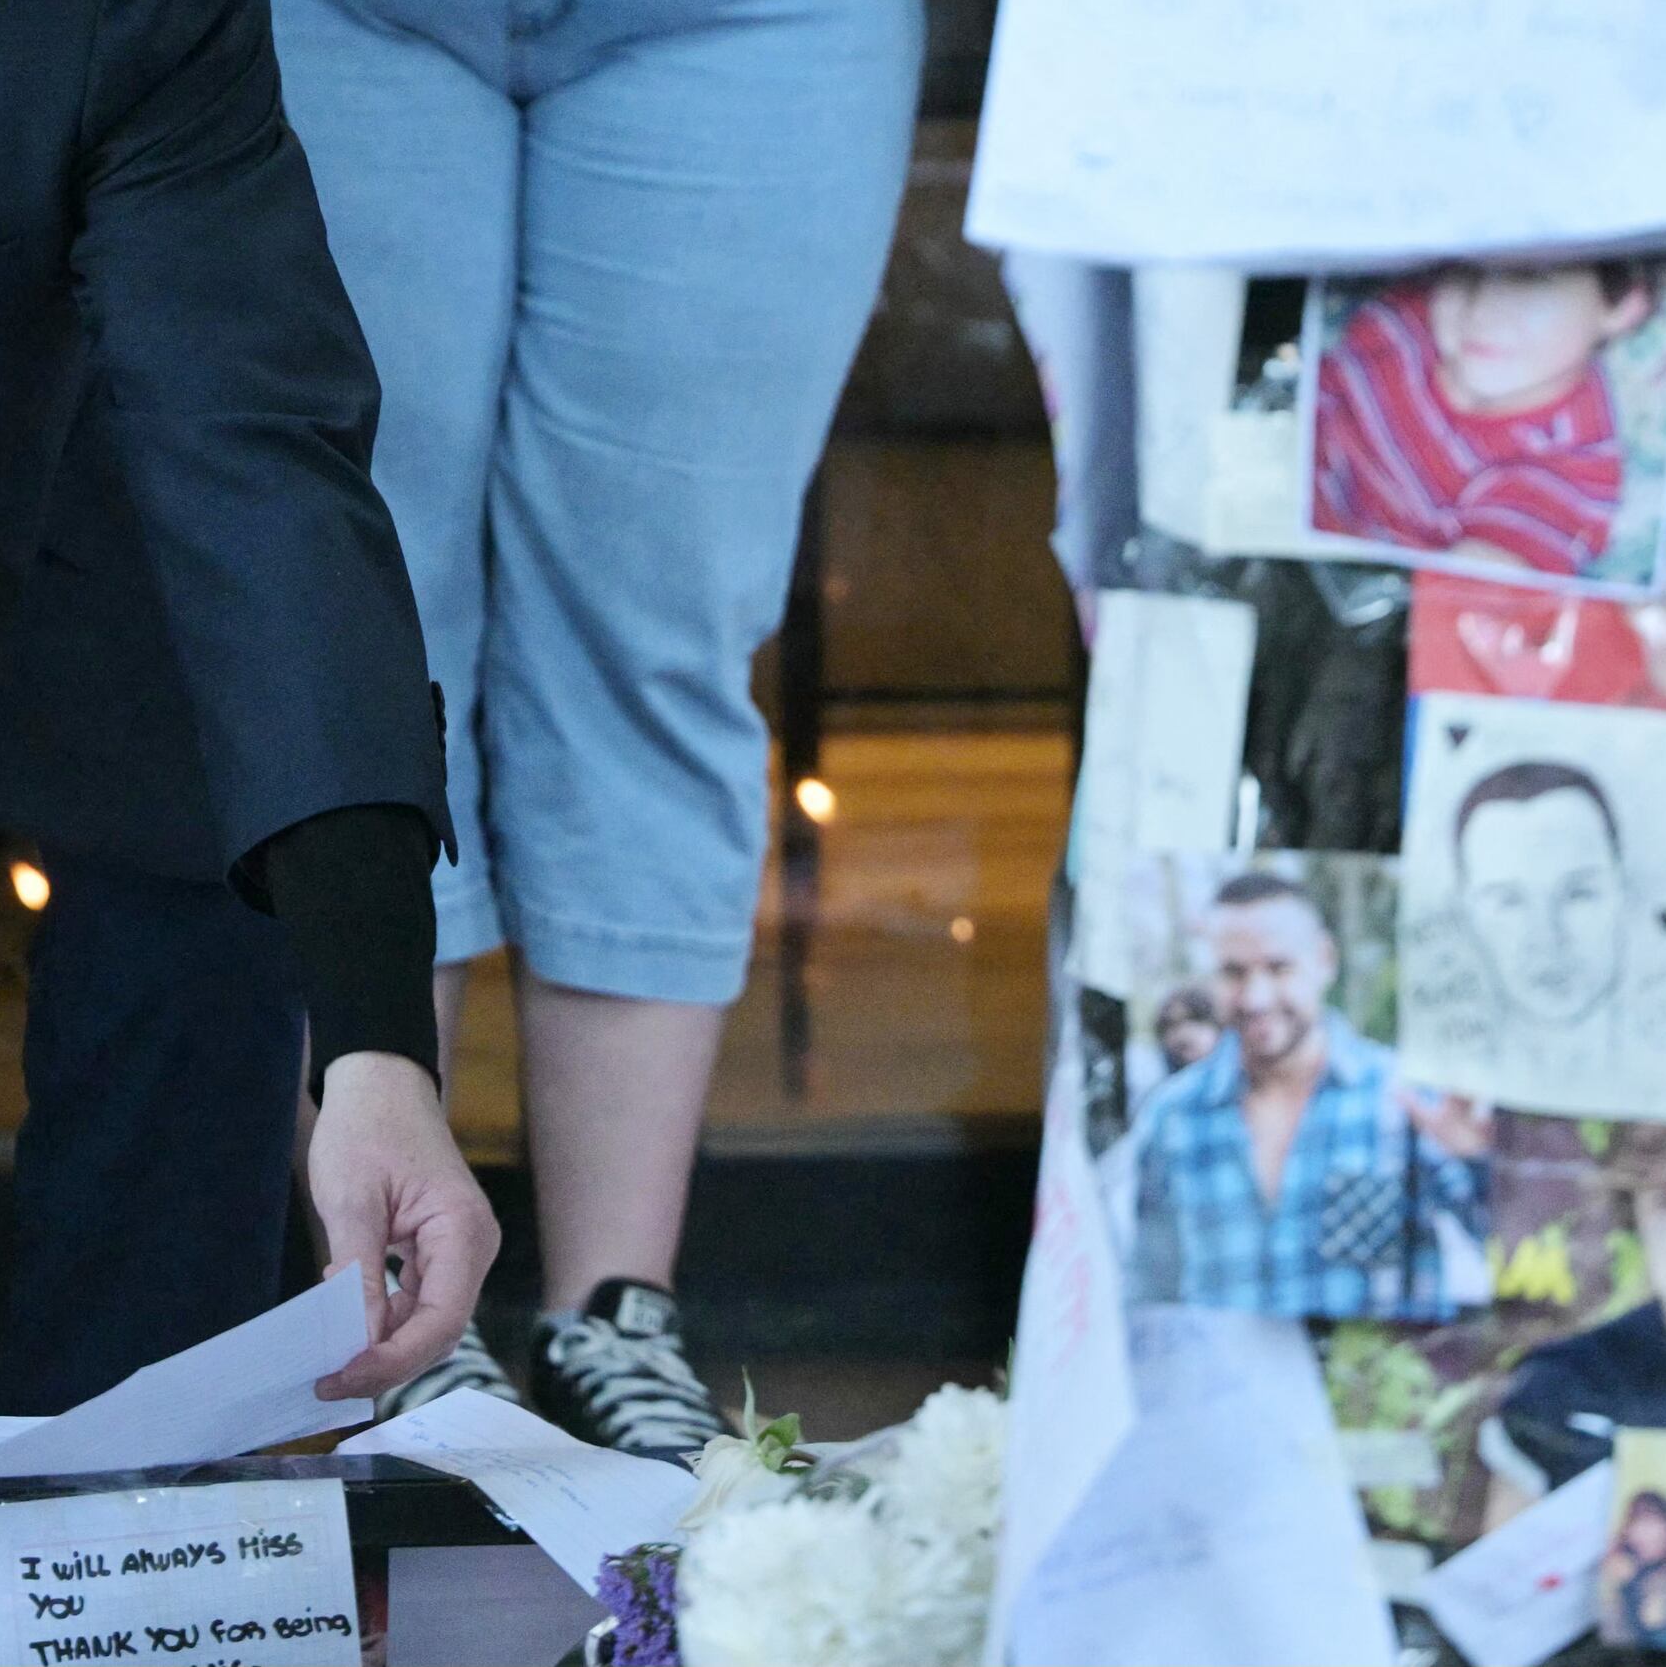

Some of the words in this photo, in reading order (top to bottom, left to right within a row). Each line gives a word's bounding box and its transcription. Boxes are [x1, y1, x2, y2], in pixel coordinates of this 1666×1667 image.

[20, 1556, 42, 1581] I
[28, 1592, 84, 1620] YOU
[29, 1631, 138, 1667] THANK
[144, 1625, 200, 1653] YOU
